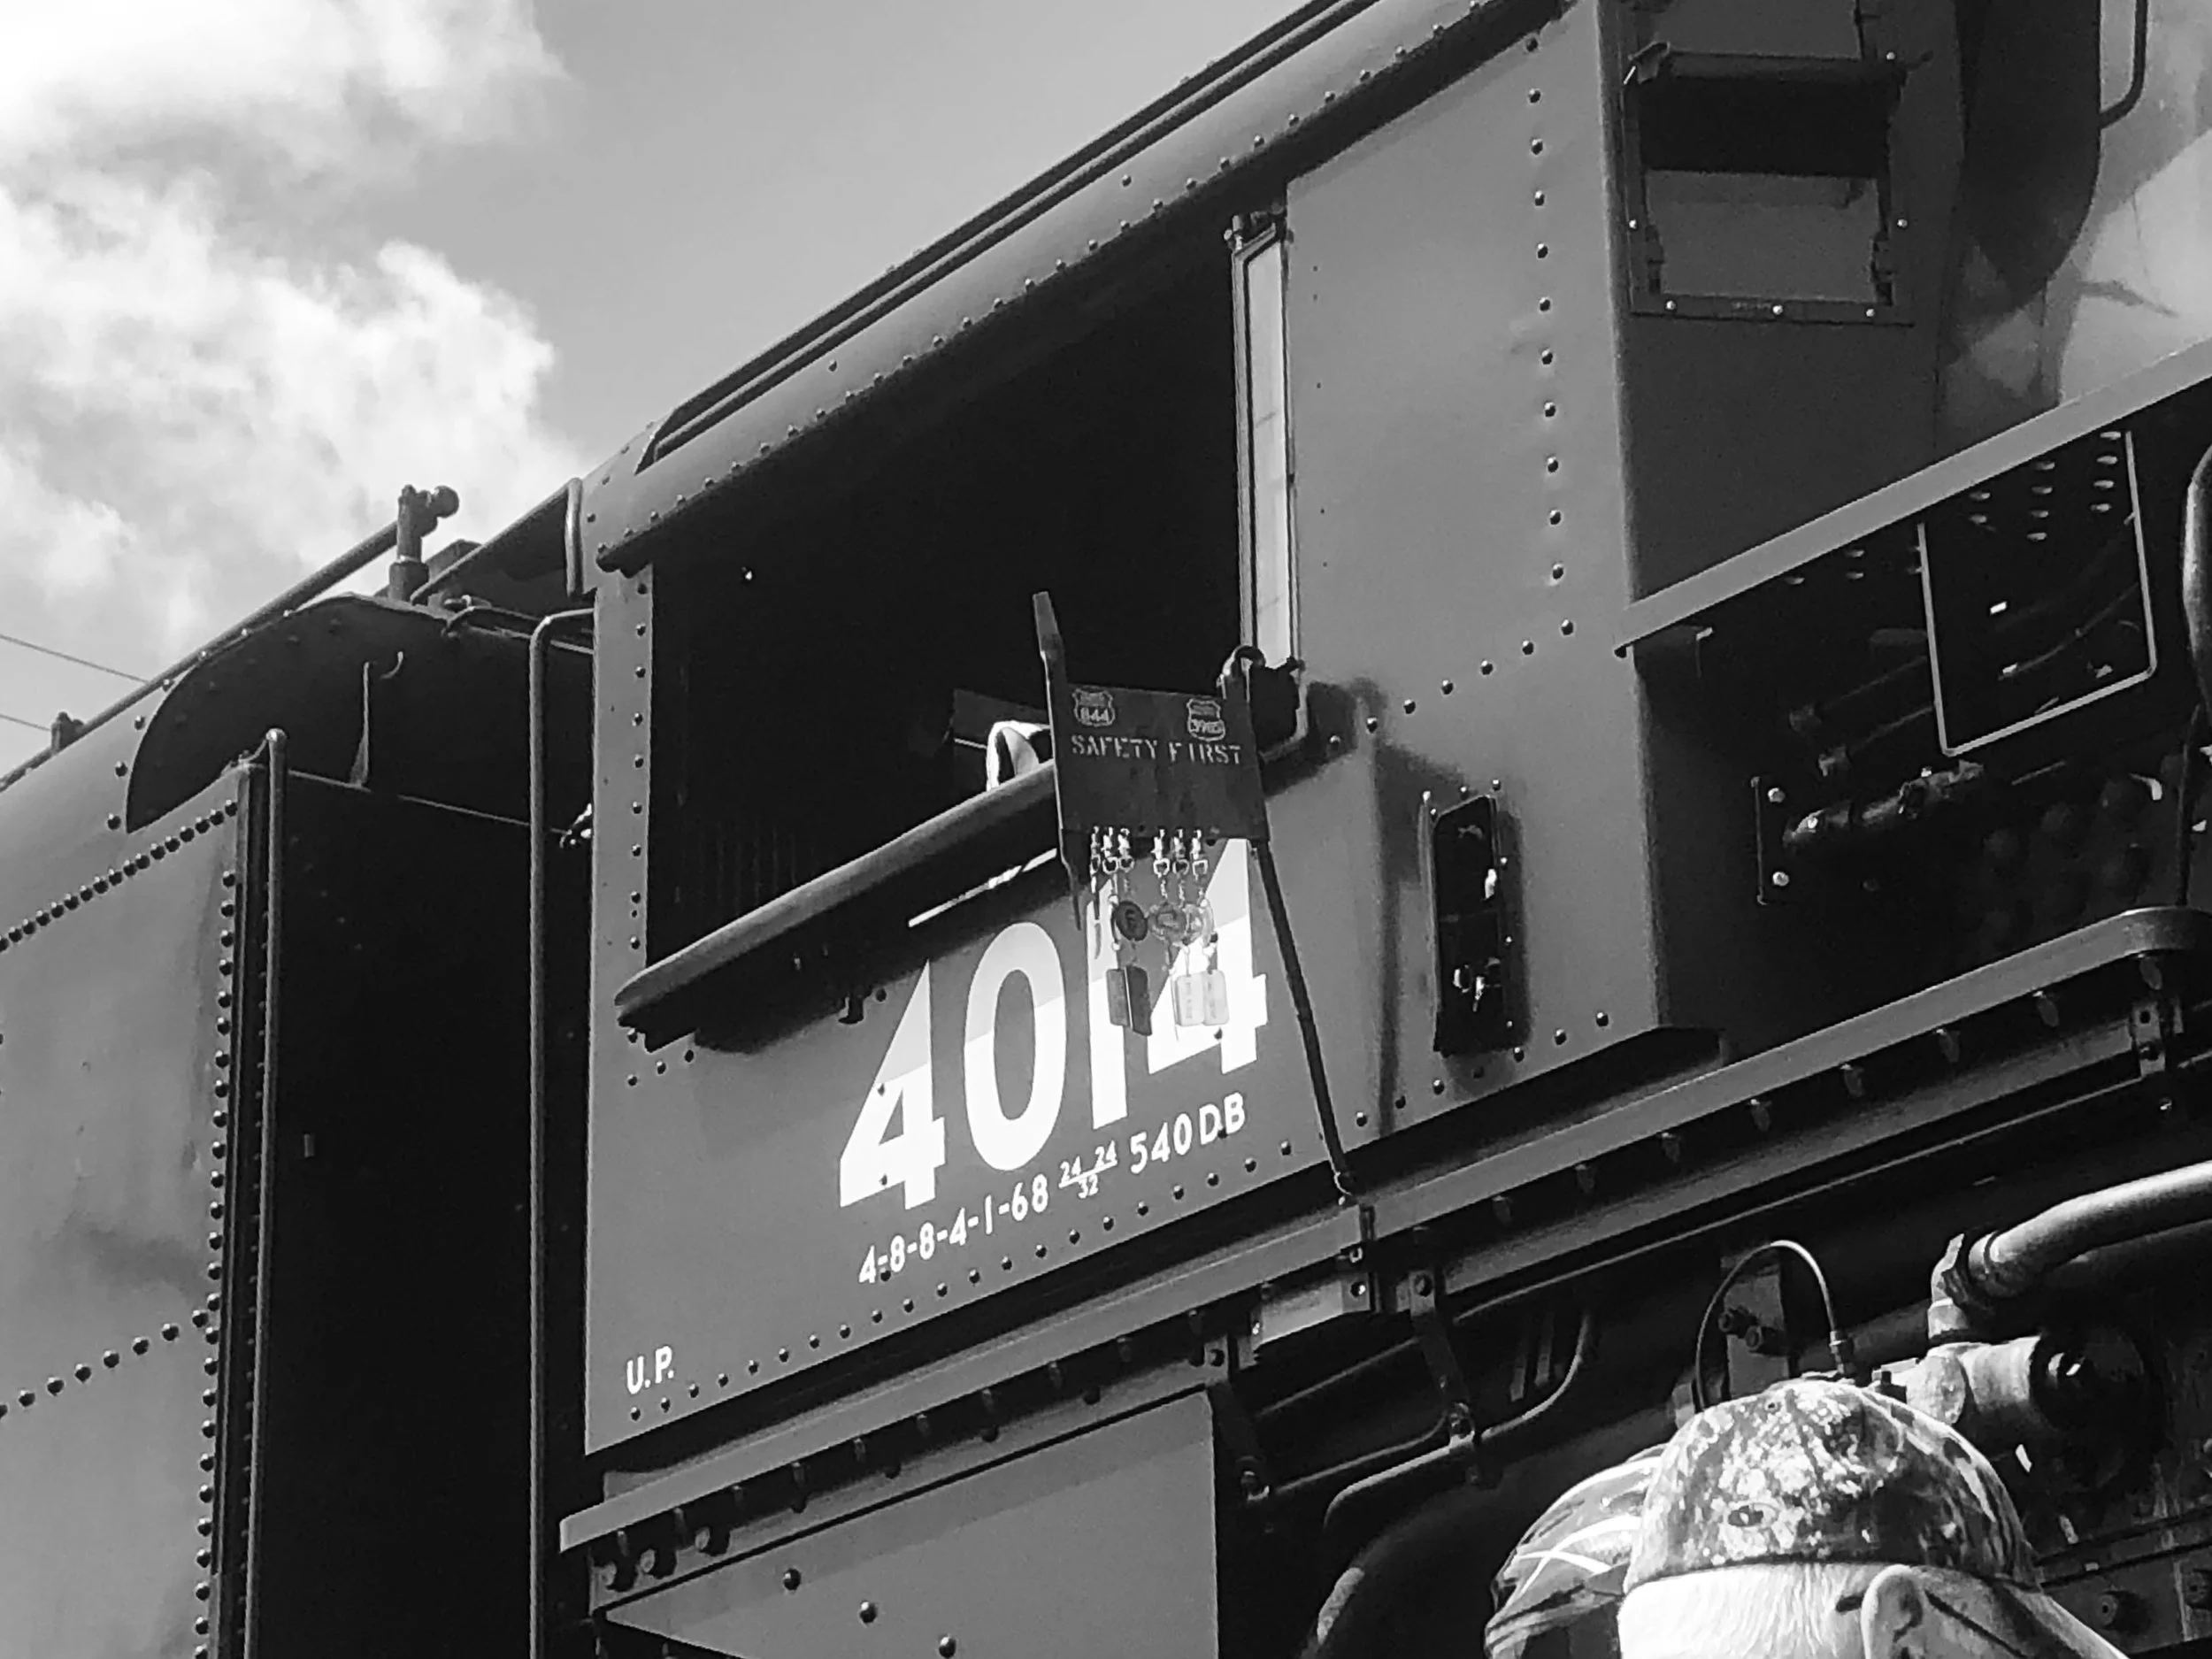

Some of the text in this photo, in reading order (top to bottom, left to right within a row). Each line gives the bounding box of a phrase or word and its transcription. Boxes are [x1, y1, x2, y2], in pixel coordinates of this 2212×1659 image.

[1071, 734, 1241, 764] SAFETY FIRST
[840, 838, 1268, 1210] 4014
[858, 1173, 1049, 1284] 4-8-8-4-1-68
[626, 1345, 675, 1395] U.P.
